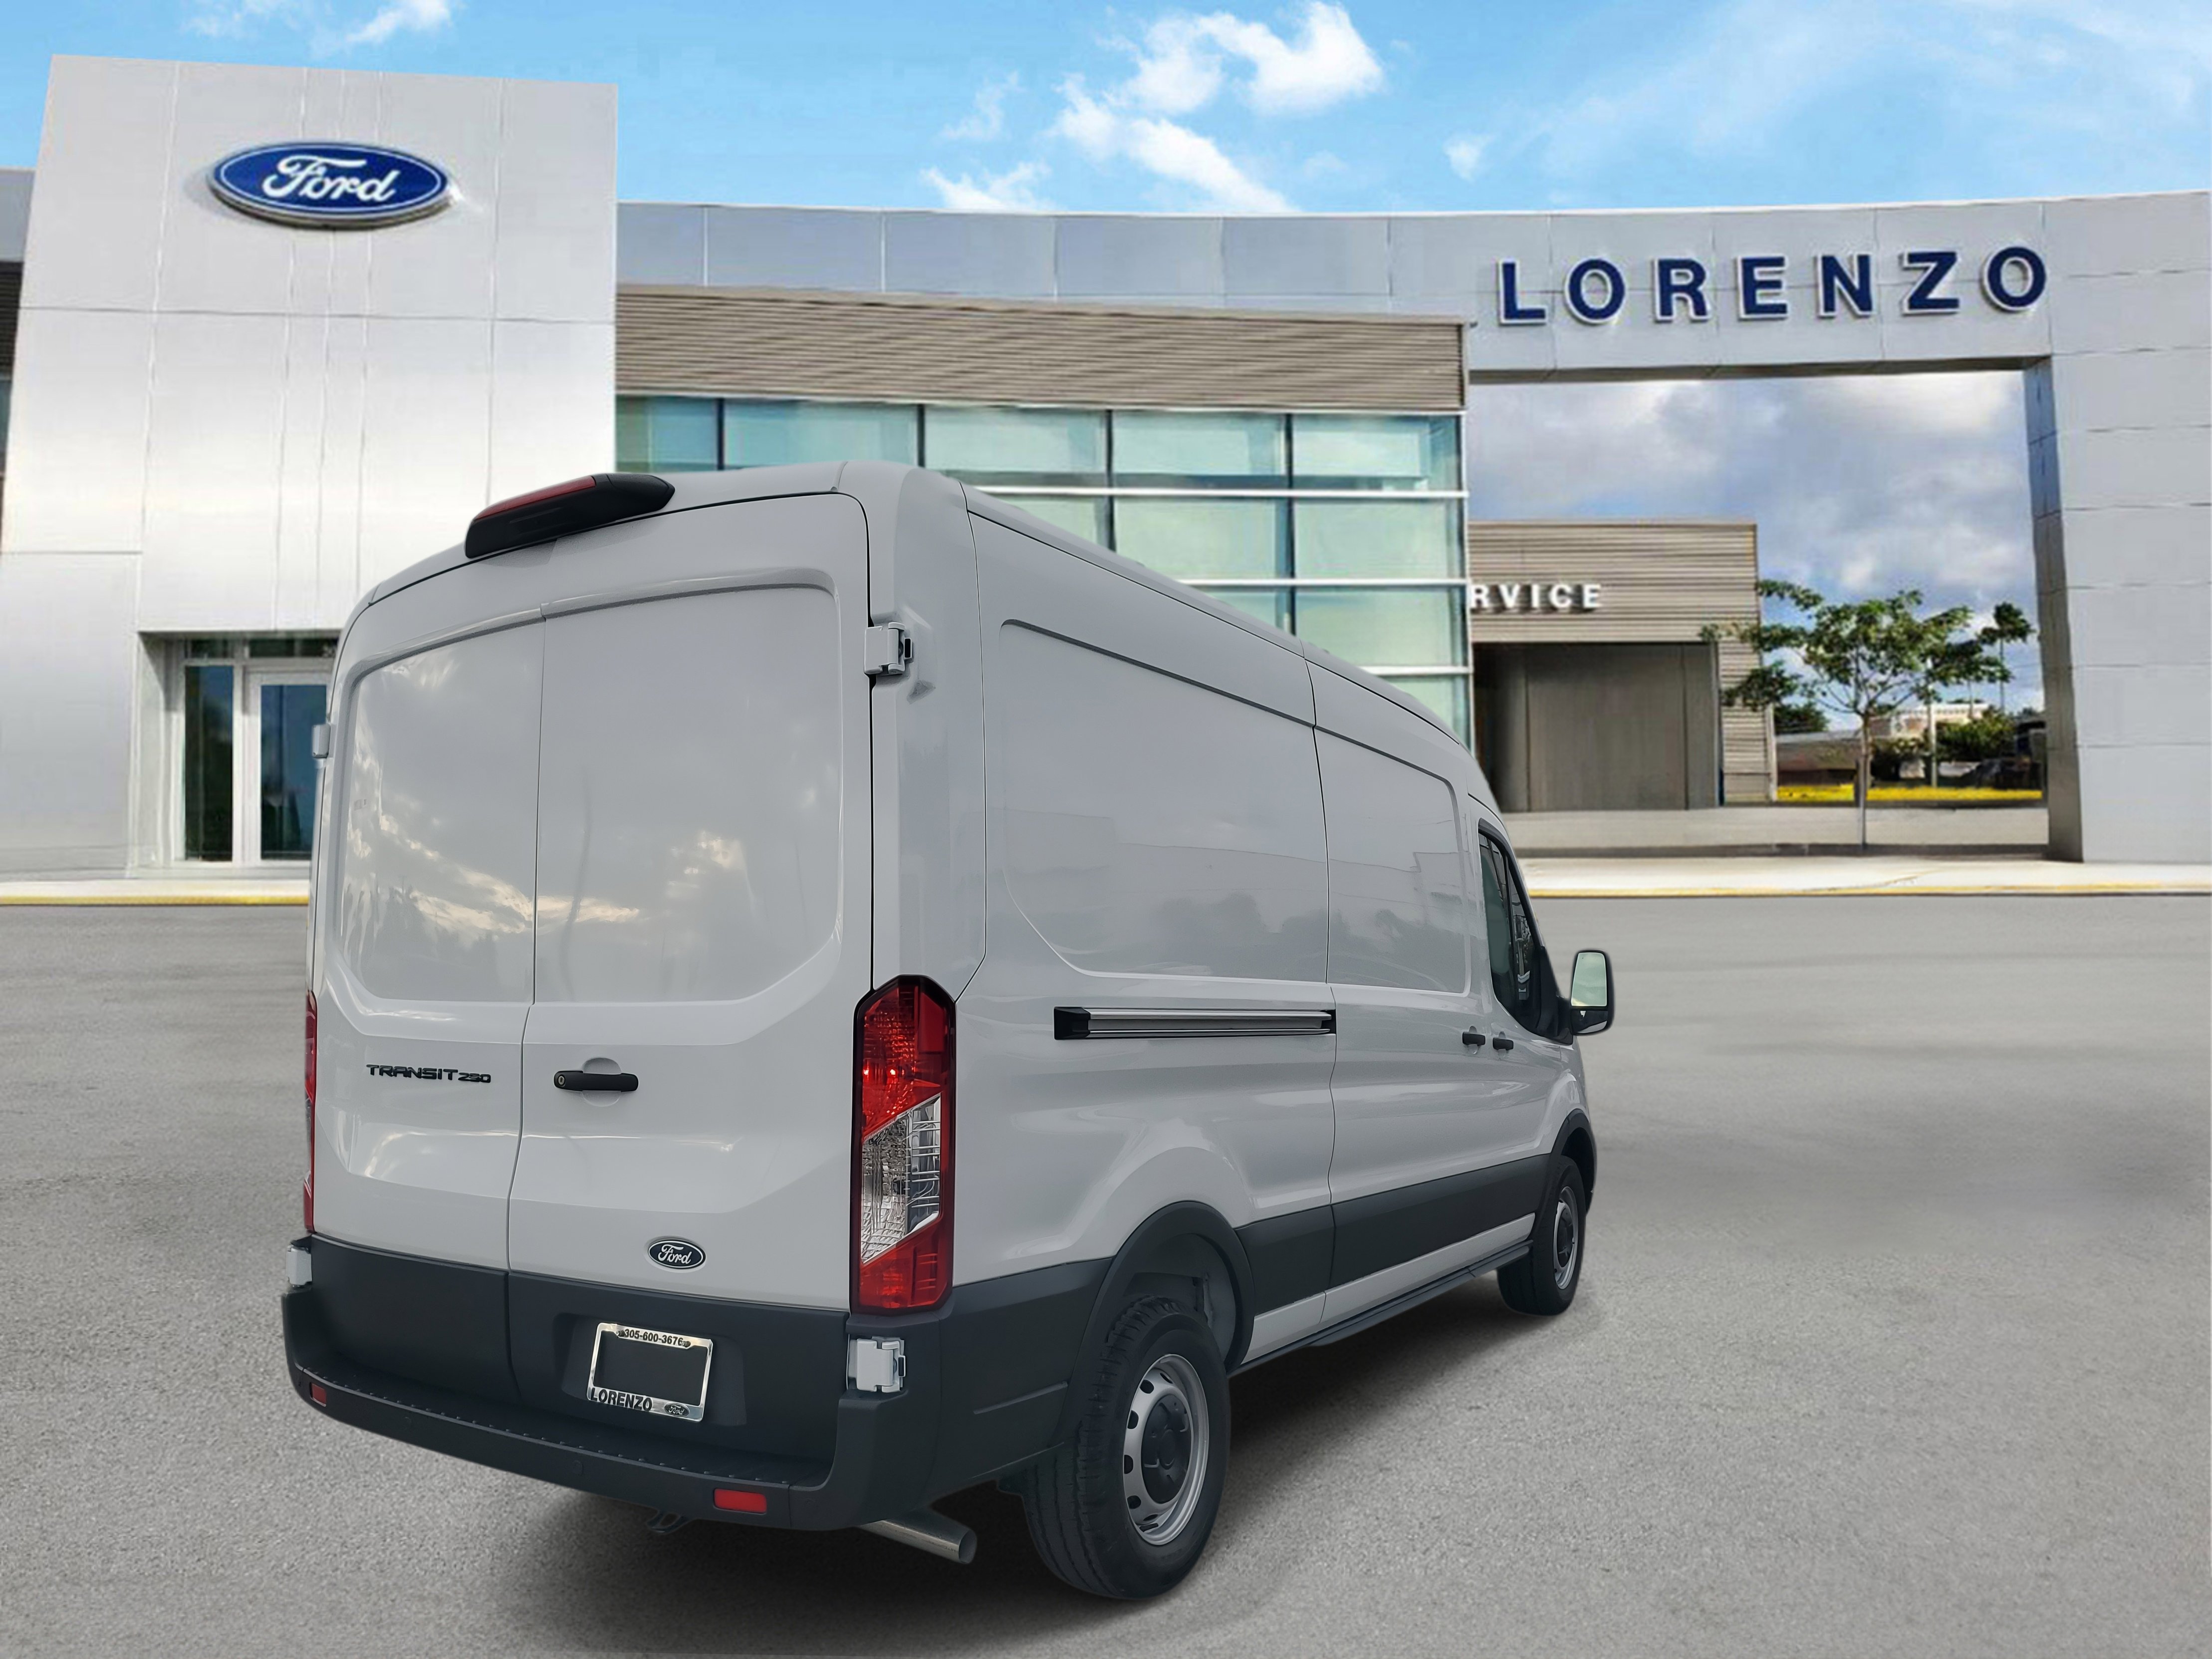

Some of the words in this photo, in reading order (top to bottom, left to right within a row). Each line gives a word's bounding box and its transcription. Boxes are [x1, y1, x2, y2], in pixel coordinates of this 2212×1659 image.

[262, 154, 400, 202] Ford
[1498, 247, 2047, 324] LORENZO
[366, 1064, 458, 1080] TRANSIT
[459, 1072, 492, 1083] 250
[658, 1244, 692, 1264] Ford
[624, 1329, 684, 1346] 305-600-3676
[590, 1388, 653, 1412] LORENZO
[668, 1405, 685, 1416] Ford
